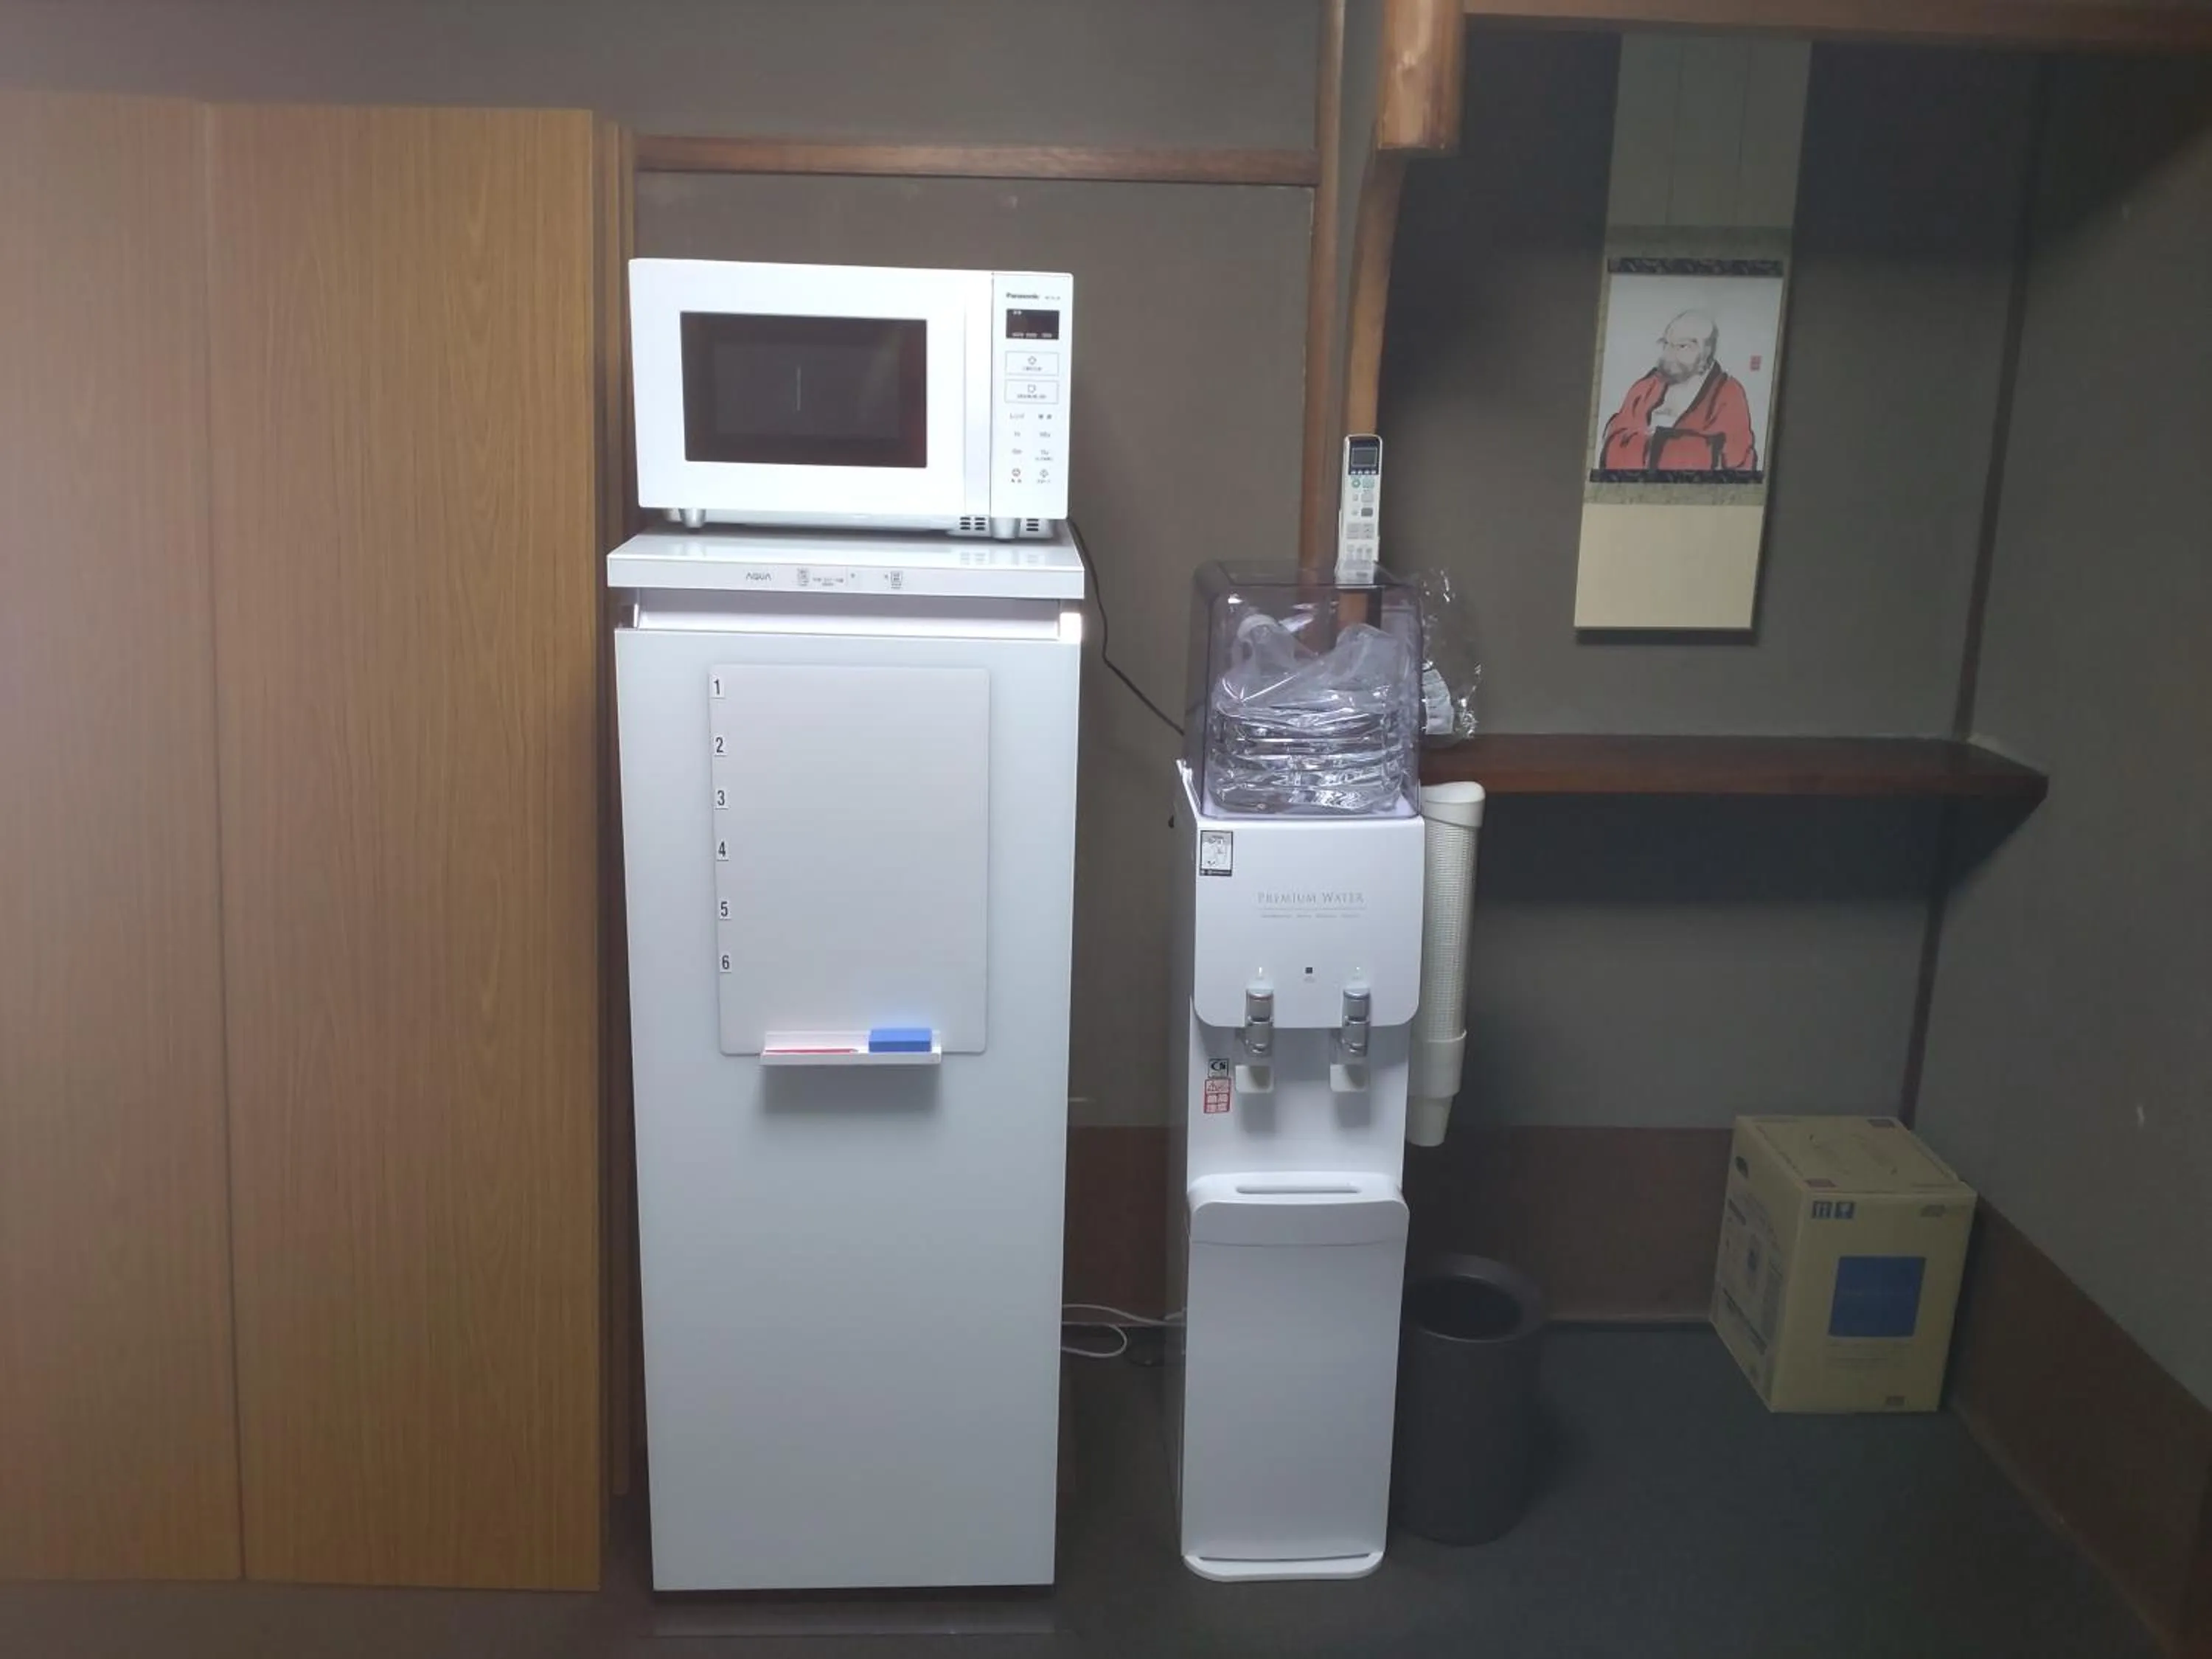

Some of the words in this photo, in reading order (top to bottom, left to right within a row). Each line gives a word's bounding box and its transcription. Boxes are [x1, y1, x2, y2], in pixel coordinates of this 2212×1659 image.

[745, 572, 772, 581] AQUA
[714, 680, 720, 695] 1
[715, 737, 723, 753] 2
[717, 790, 725, 806] 3
[718, 841, 726, 857] 4
[1322, 891, 1365, 903] WATER
[720, 901, 728, 917] 5
[722, 955, 729, 970] 6
